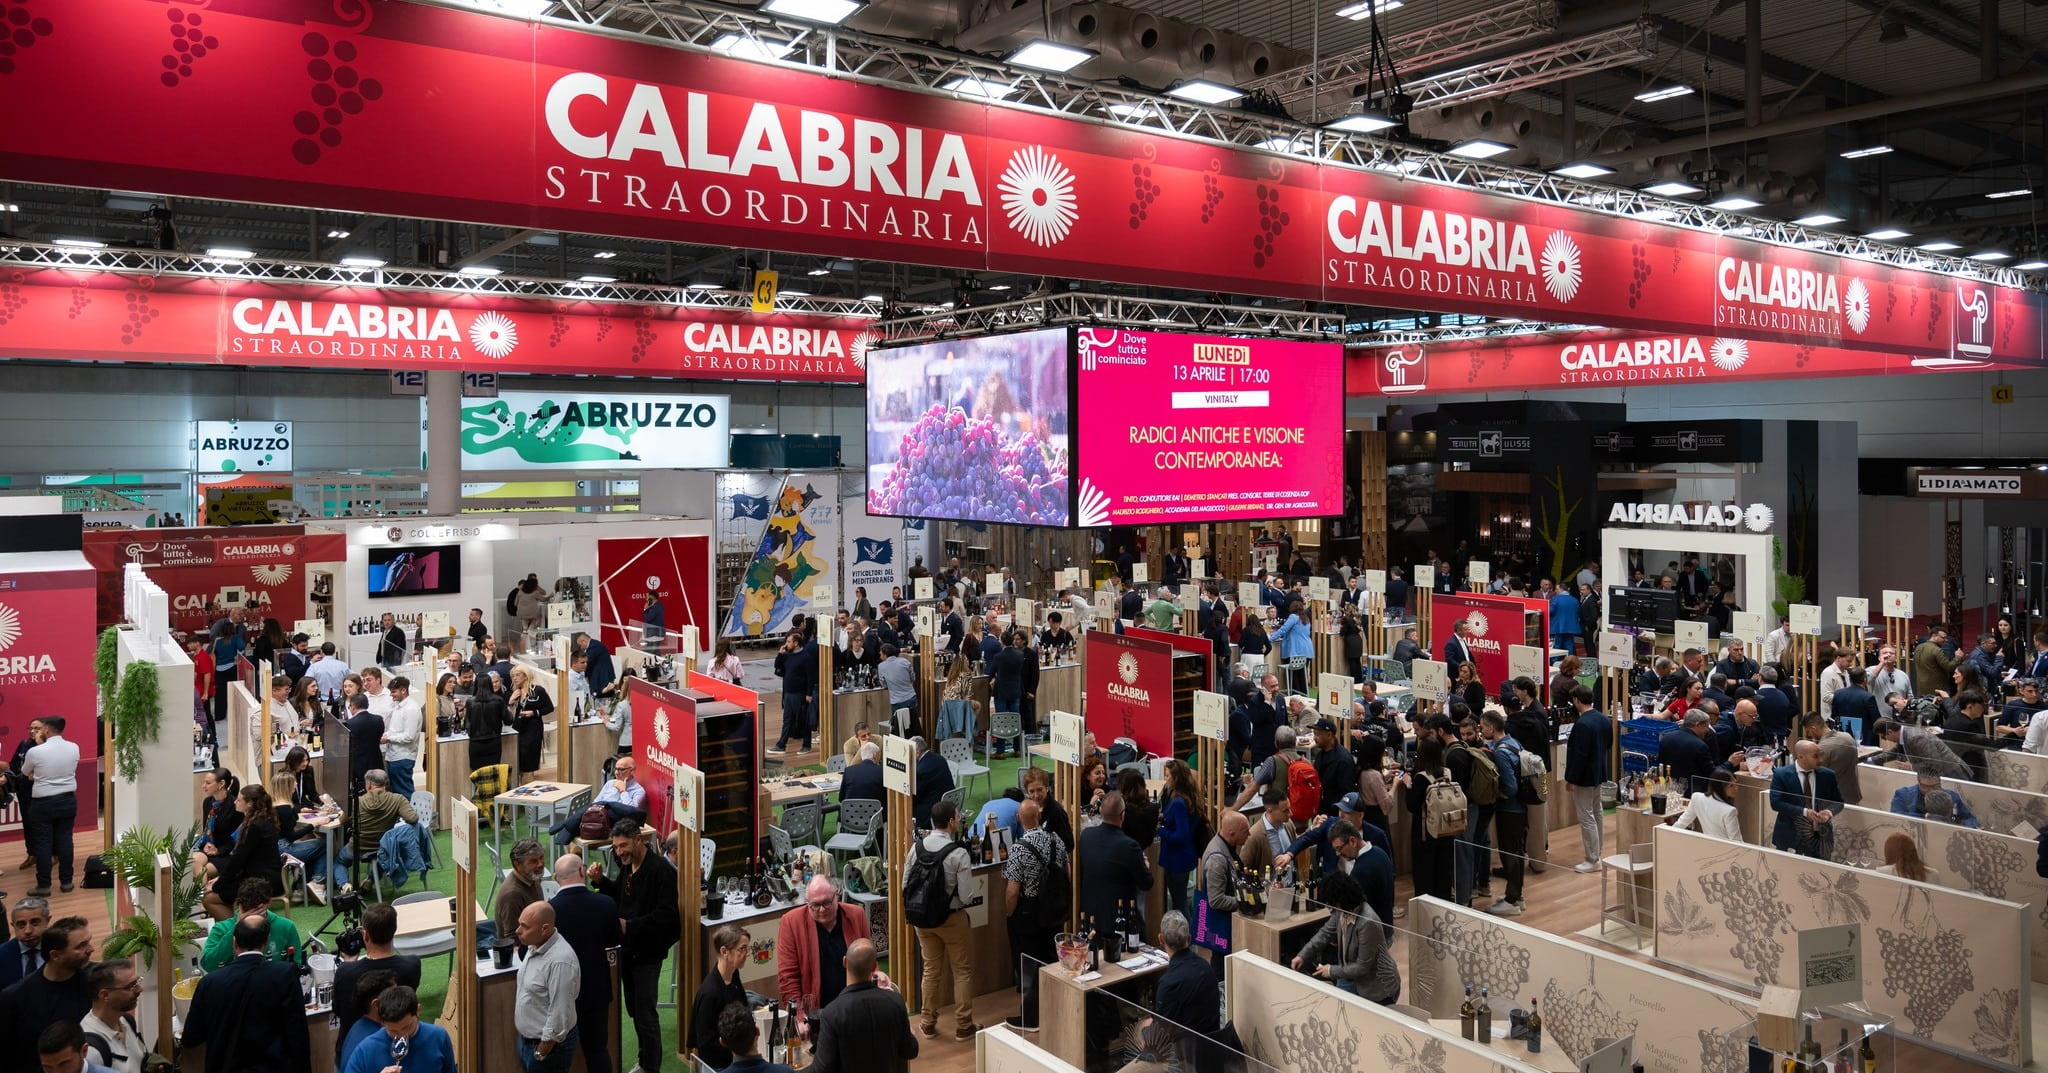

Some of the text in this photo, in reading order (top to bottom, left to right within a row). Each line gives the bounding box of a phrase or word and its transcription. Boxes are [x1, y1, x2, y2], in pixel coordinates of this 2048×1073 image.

[544, 72, 983, 206] CALABRIA
[545, 166, 984, 246] STRAORDINARIA
[1327, 195, 1537, 274] CALABRIA
[1328, 258, 1538, 303] STRAORDINARIA
[1718, 257, 1840, 314] CALABRIA
[757, 279, 772, 304] C3
[232, 298, 462, 342] CALABRIA
[1718, 304, 1842, 335] STRAORDINARIA
[233, 336, 462, 360] STRAORDINARIA
[684, 322, 845, 358] CALABRIA
[1123, 334, 1147, 344] Dove
[1118, 344, 1147, 355] tutto è
[1560, 337, 1706, 371] CALABRIA
[684, 355, 846, 373] STRAORDINARIA
[1097, 354, 1147, 365] cominciato
[395, 372, 495, 387] 12 12
[1173, 365, 1270, 384] 13 APRILE 17:00
[1560, 366, 1707, 384] STRAORDINARIA
[1204, 394, 1239, 404] VINITALY
[561, 402, 717, 428] ABRUZZO
[202, 438, 290, 450] ABRUZZO
[1129, 426, 1305, 444] RADICI ANTICHE E VISIONE
[1154, 451, 1284, 469] CONTEMPORANEA:
[187, 549, 193, 557] è
[223, 544, 280, 555] CALABRIA
[163, 556, 213, 565] cominciato
[852, 568, 894, 577] VITICOLTORI DEL
[852, 576, 894, 585] MEDITERRANEO
[1621, 660, 1630, 668] 57
[1107, 682, 1150, 702] CALABRIA
[1342, 708, 1350, 717] 54
[1215, 728, 1225, 739] 53
[646, 745, 679, 770] CALABRIA
[1071, 752, 1080, 764] 52
[1629, 993, 1666, 1013] Pecorello
[1644, 1043, 1688, 1065] Magliocco
